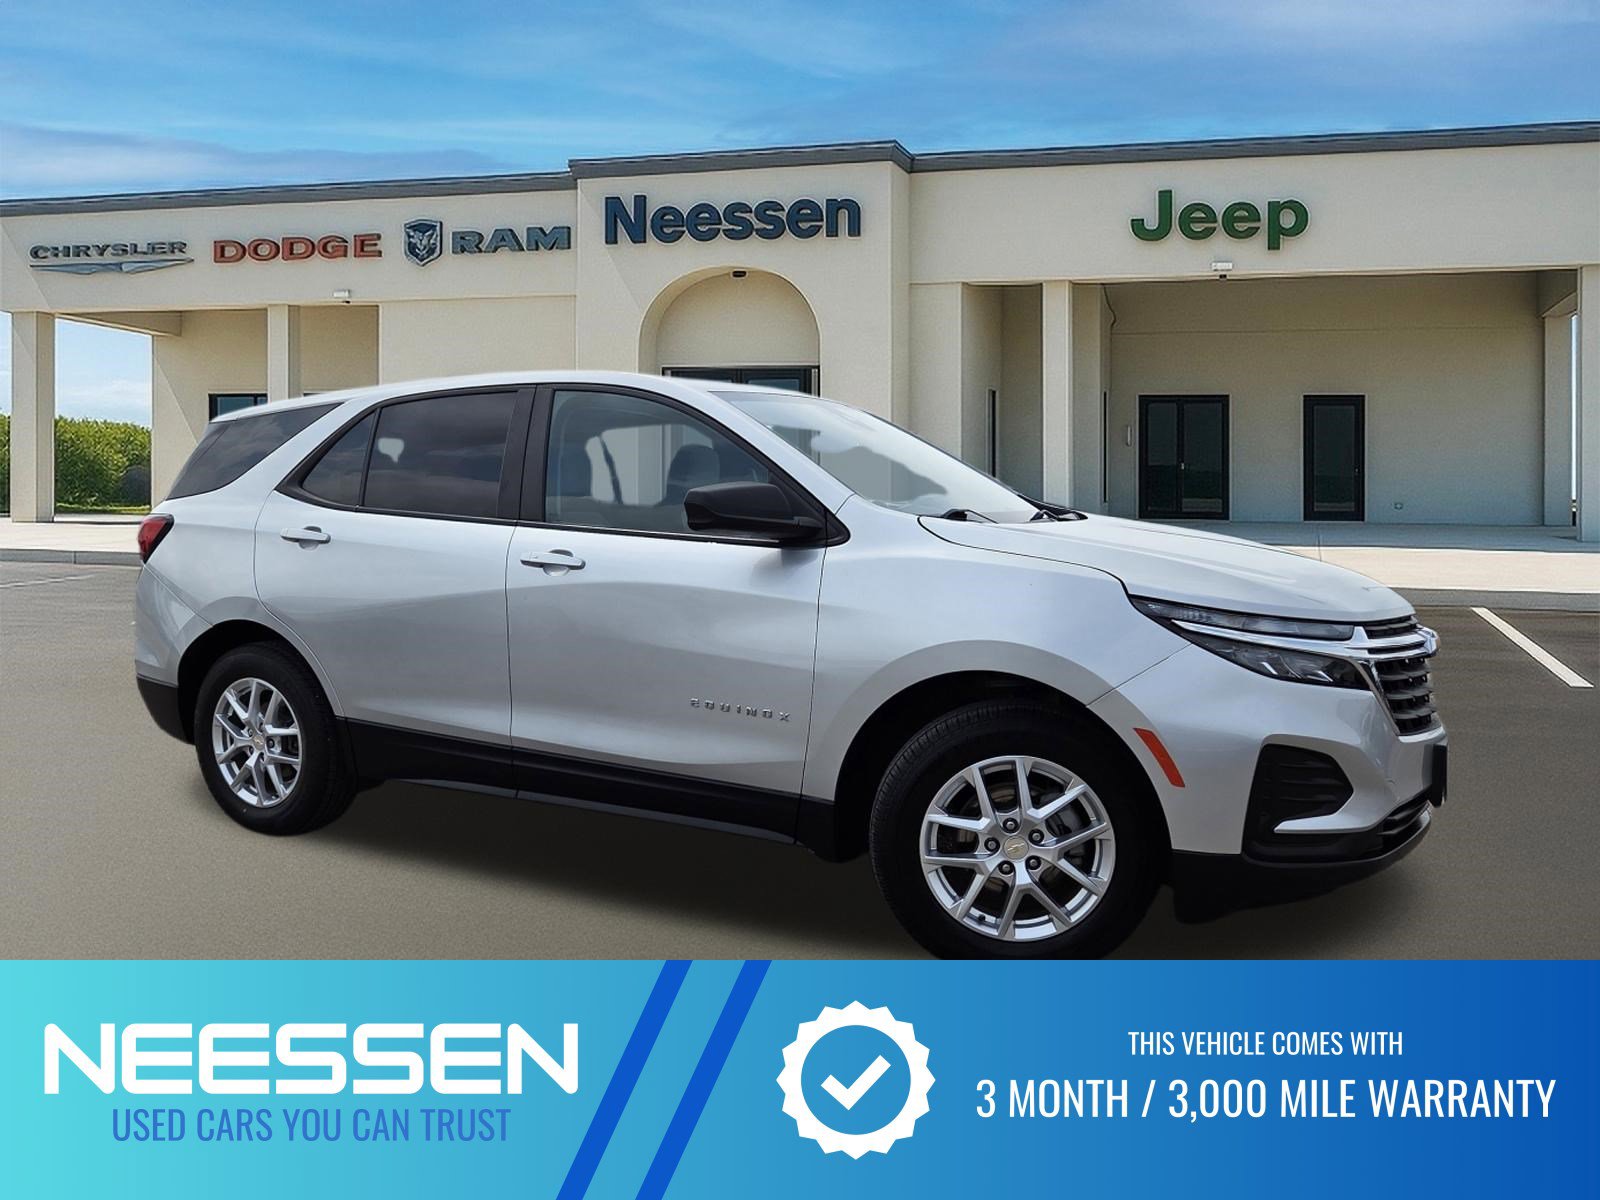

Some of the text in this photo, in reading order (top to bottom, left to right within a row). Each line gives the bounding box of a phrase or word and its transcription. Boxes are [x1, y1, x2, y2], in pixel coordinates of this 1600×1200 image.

[604, 193, 862, 245] Neessen
[1131, 190, 1309, 250] Jeep
[29, 241, 187, 259] CHRYSLER
[213, 233, 382, 264] DODGE
[451, 225, 571, 255] RAM
[690, 698, 791, 722] EQUINOX
